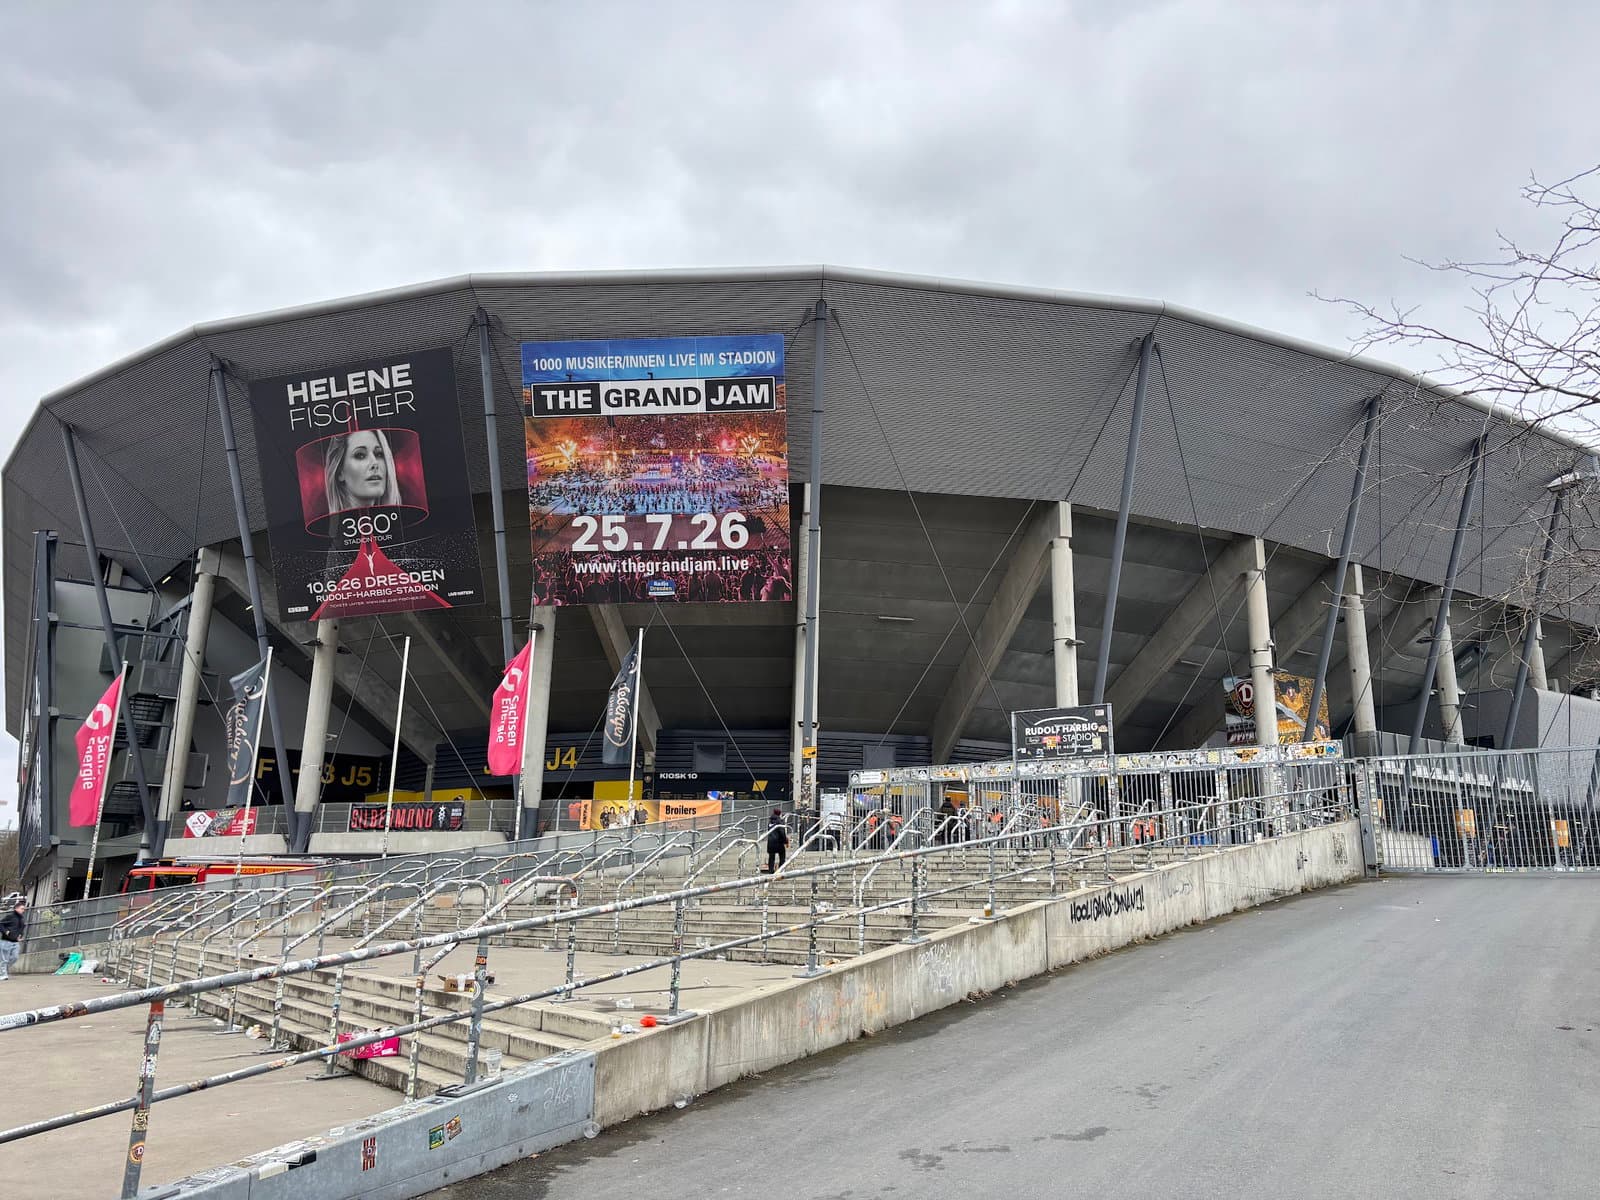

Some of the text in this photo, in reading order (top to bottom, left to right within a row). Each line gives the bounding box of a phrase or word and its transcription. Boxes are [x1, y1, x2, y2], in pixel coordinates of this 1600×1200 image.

[533, 350, 776, 371] 1000 MUSIKER/INNEN LIVE IM STADION
[287, 363, 412, 405] HELENE
[541, 383, 770, 410] THE GRAND JAM
[289, 390, 416, 431] FISCHER
[344, 534, 393, 546] STADION TOUR
[571, 512, 749, 552] 25.7.26
[574, 556, 749, 576] www.thegrandjam.live
[306, 569, 445, 595] 10.6.26 DRESDEN
[315, 583, 439, 603] RUDOLF-HARBIG-STADION
[507, 695, 519, 747] Sachsen
[1025, 722, 1098, 736] RUDOLF HARBIG
[546, 747, 577, 771] J4
[341, 766, 372, 786] J5
[665, 804, 697, 815] Broilers
